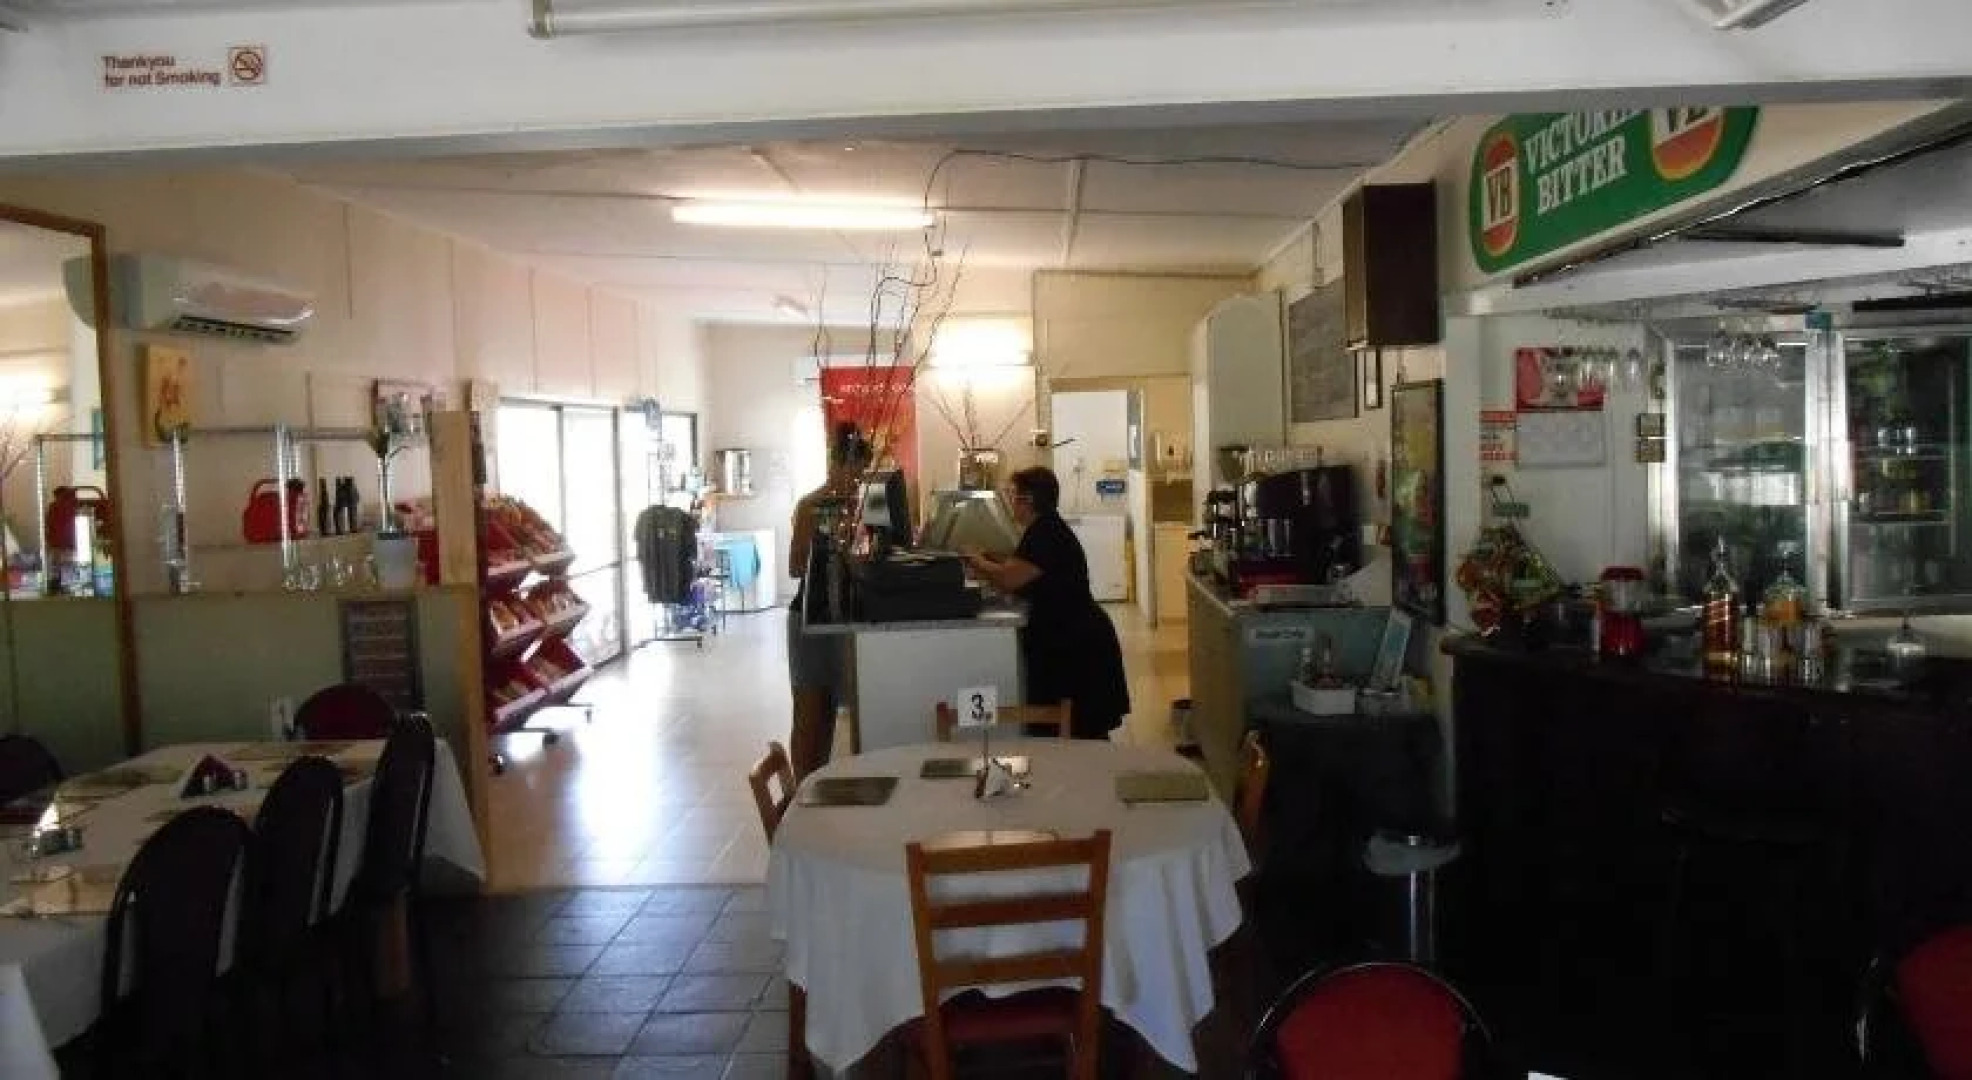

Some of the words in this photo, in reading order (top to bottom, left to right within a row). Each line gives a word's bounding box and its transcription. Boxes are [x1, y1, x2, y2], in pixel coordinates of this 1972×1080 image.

[104, 73, 124, 88] for
[128, 74, 151, 86] not
[154, 70, 222, 87] Smoking
[1525, 107, 1645, 175] VICTOR
[1486, 165, 1513, 223] VB
[1537, 135, 1628, 216] BITTER
[971, 694, 985, 720] 3
